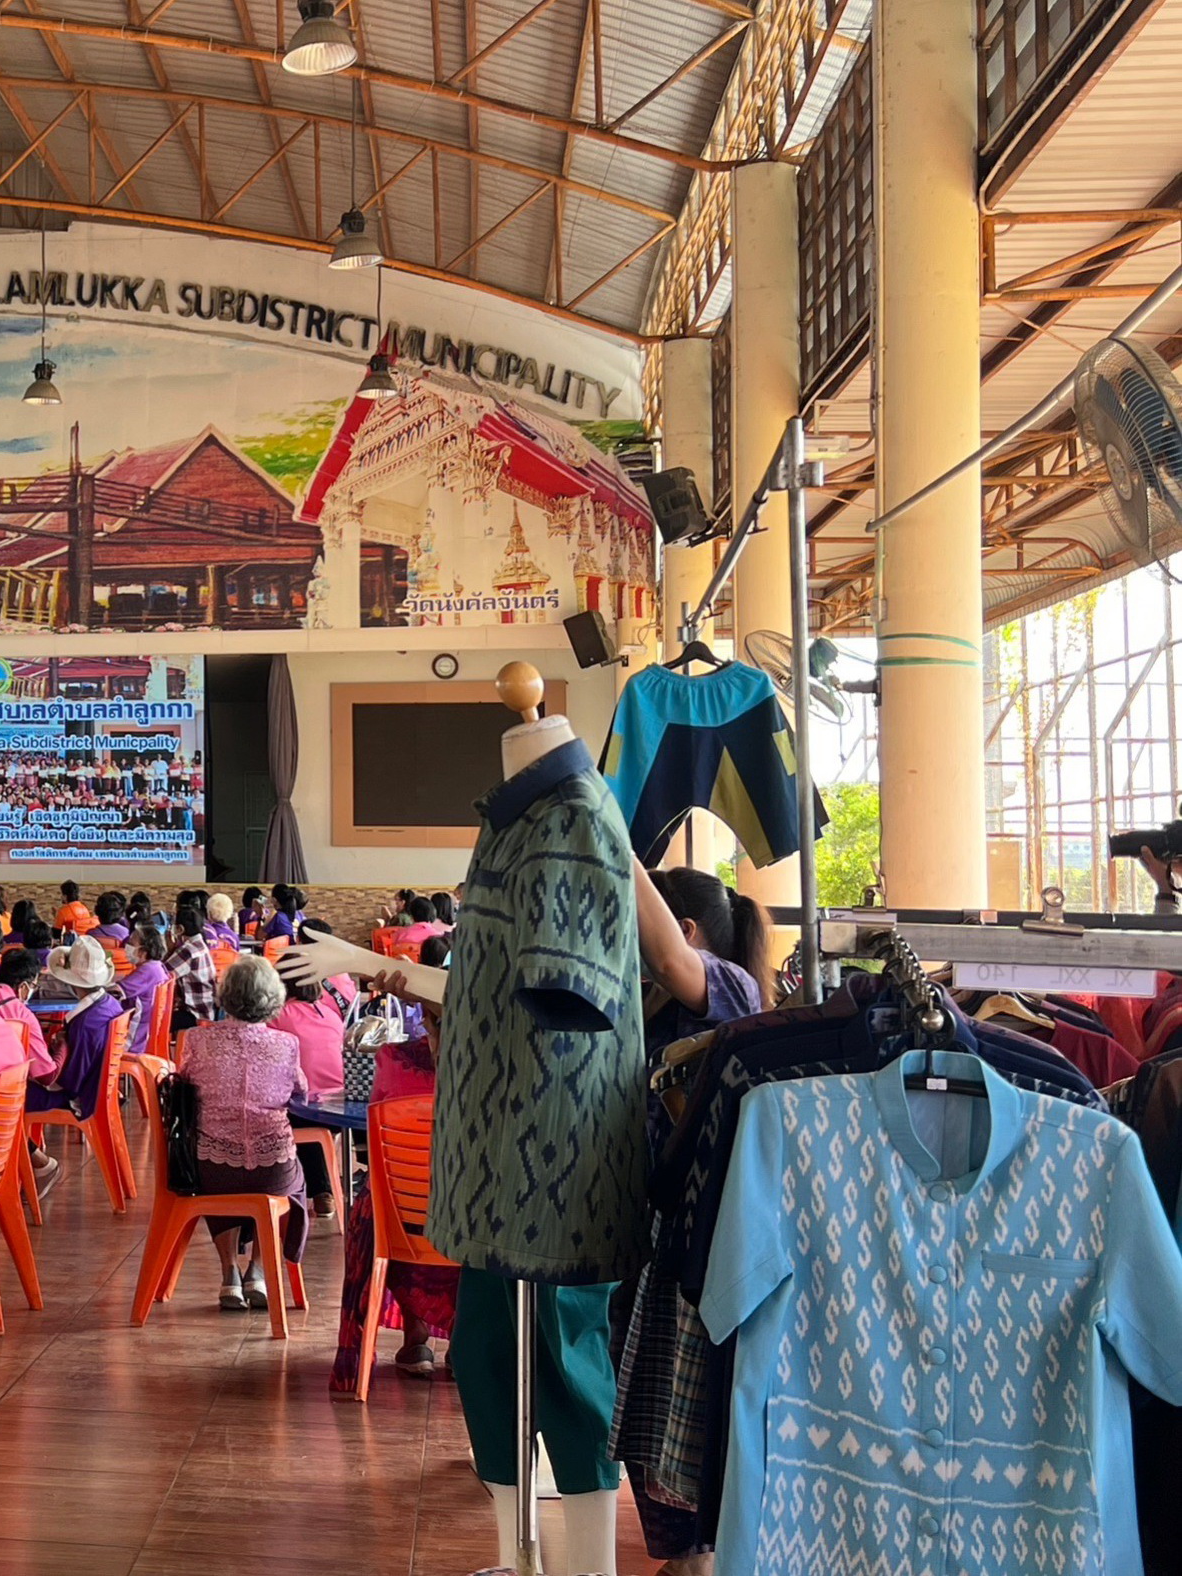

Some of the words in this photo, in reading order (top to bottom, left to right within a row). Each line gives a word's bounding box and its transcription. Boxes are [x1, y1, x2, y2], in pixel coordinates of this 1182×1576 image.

[177, 282, 377, 350] SUBDISTRICT
[387, 319, 621, 418] MUNICIPALITY
[10, 736, 90, 750] Subdistrict
[95, 736, 181, 752] Municpality
